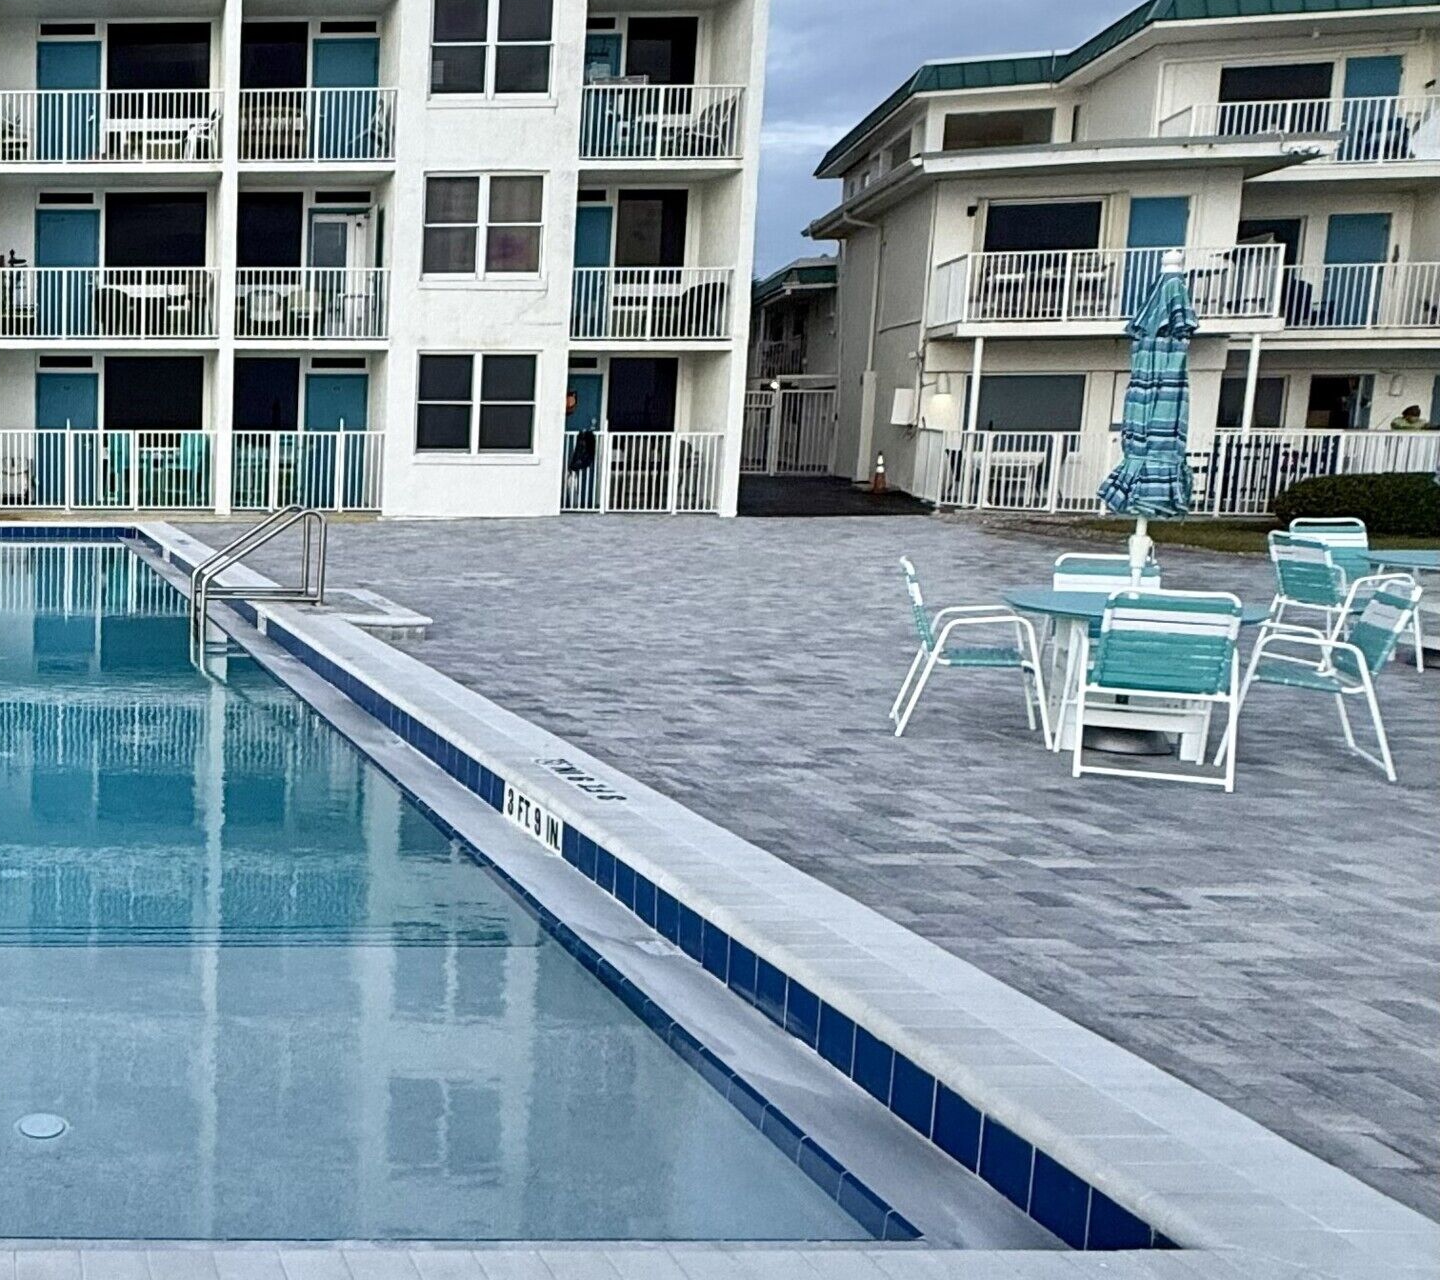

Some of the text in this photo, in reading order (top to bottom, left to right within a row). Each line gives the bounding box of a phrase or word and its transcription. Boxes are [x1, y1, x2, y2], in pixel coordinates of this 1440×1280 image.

[507, 788, 514, 816] 3
[534, 807, 542, 837] 9
[546, 815, 561, 851] IN.
